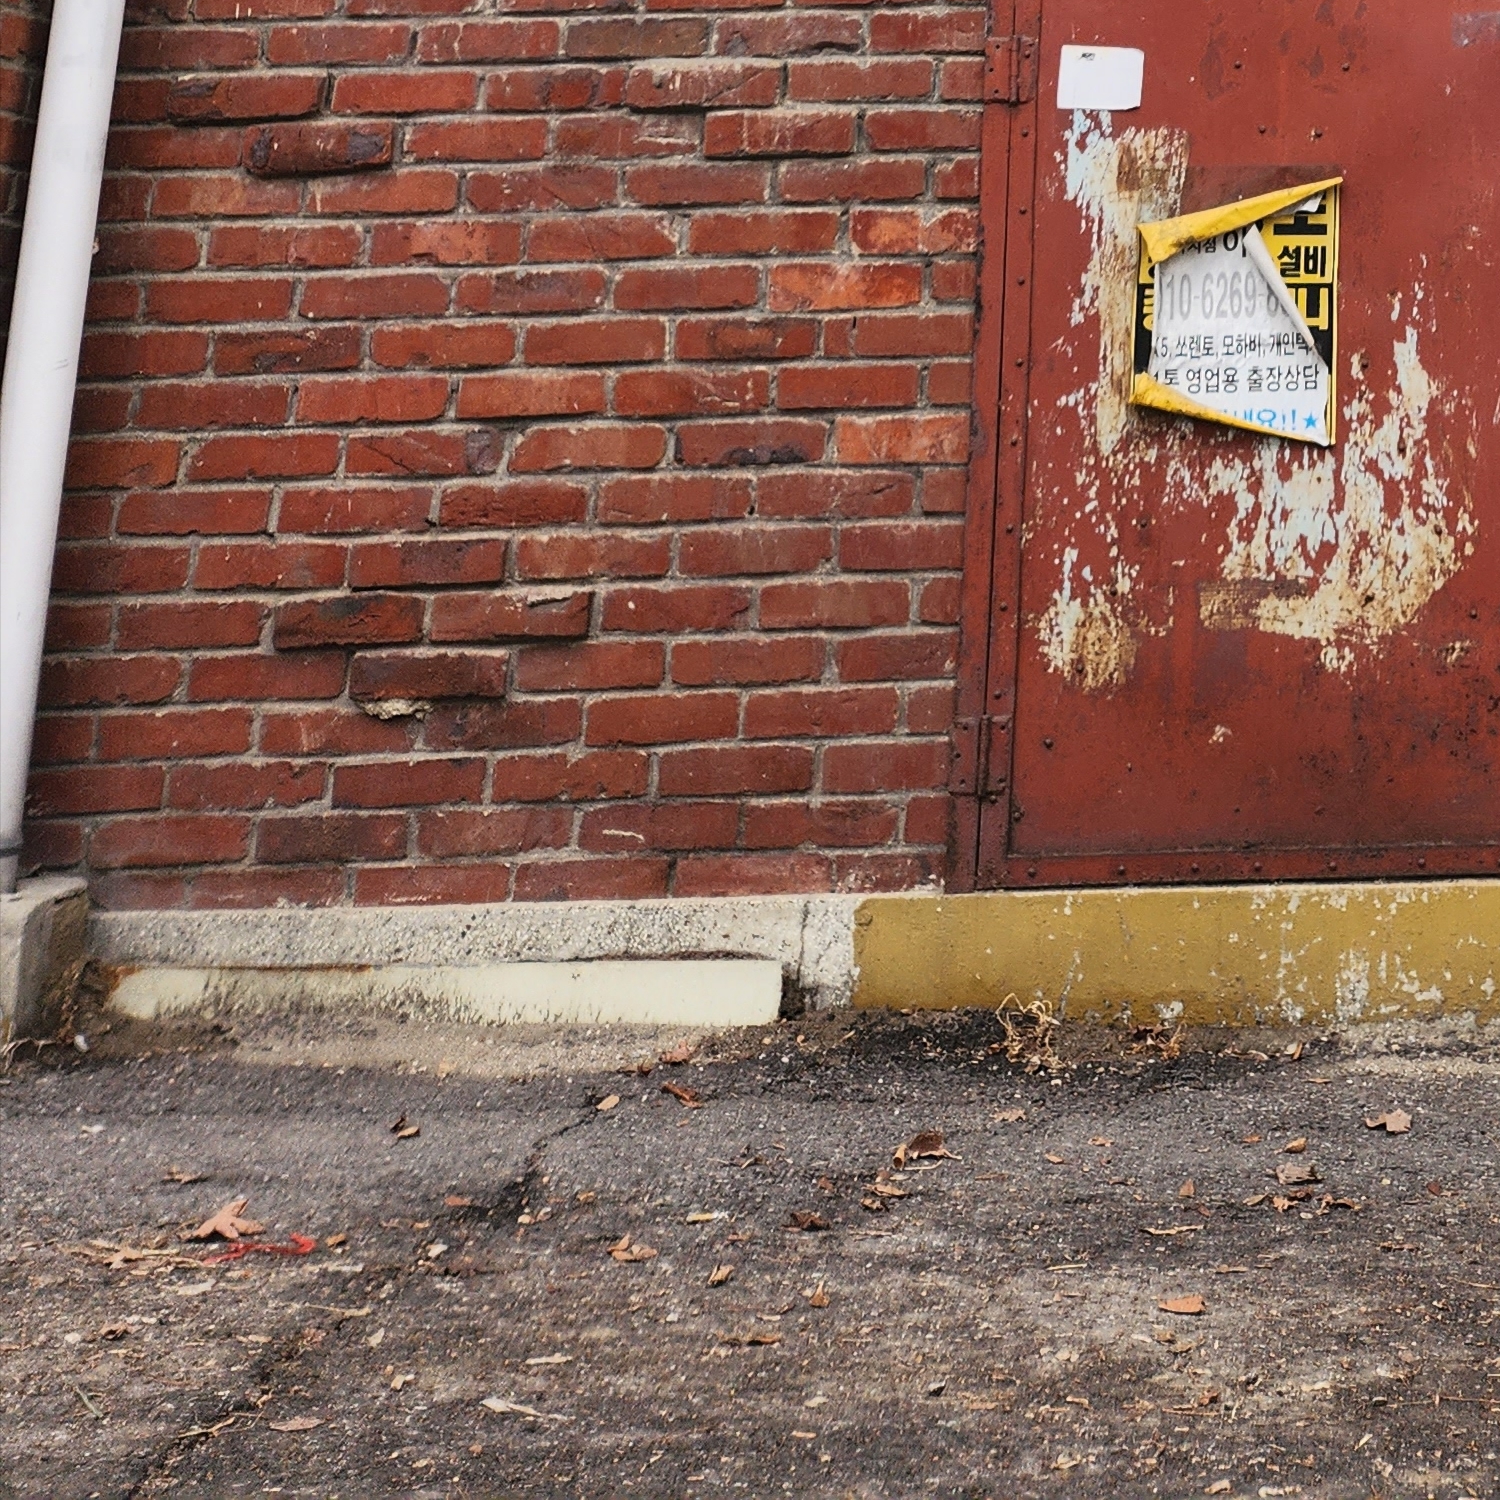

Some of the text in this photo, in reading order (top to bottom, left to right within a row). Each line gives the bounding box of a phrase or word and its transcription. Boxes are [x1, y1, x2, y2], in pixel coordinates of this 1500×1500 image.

[1277, 245, 1327, 278] 설비
[1269, 332, 1313, 356] 개인택
[1186, 367, 1240, 394] 영업용
[1247, 364, 1320, 393] 출장상담
